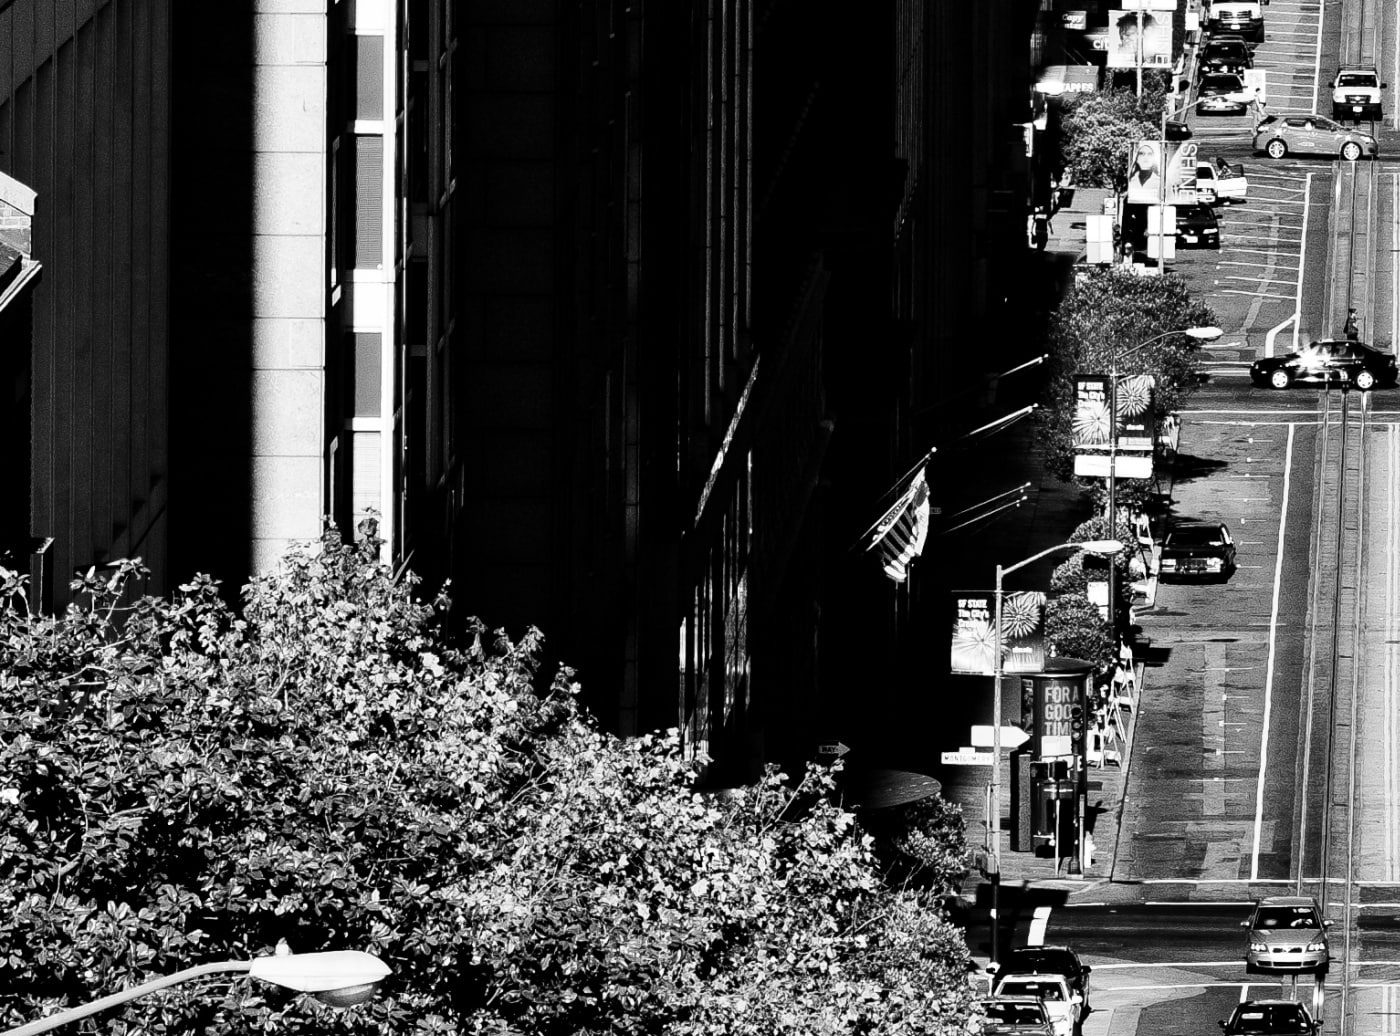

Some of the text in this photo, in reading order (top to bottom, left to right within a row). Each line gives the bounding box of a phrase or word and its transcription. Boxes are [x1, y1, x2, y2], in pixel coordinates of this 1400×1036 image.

[1045, 685, 1080, 703] FOR A
[1045, 703, 1074, 721] GOO
[1044, 721, 1073, 736] TIM
